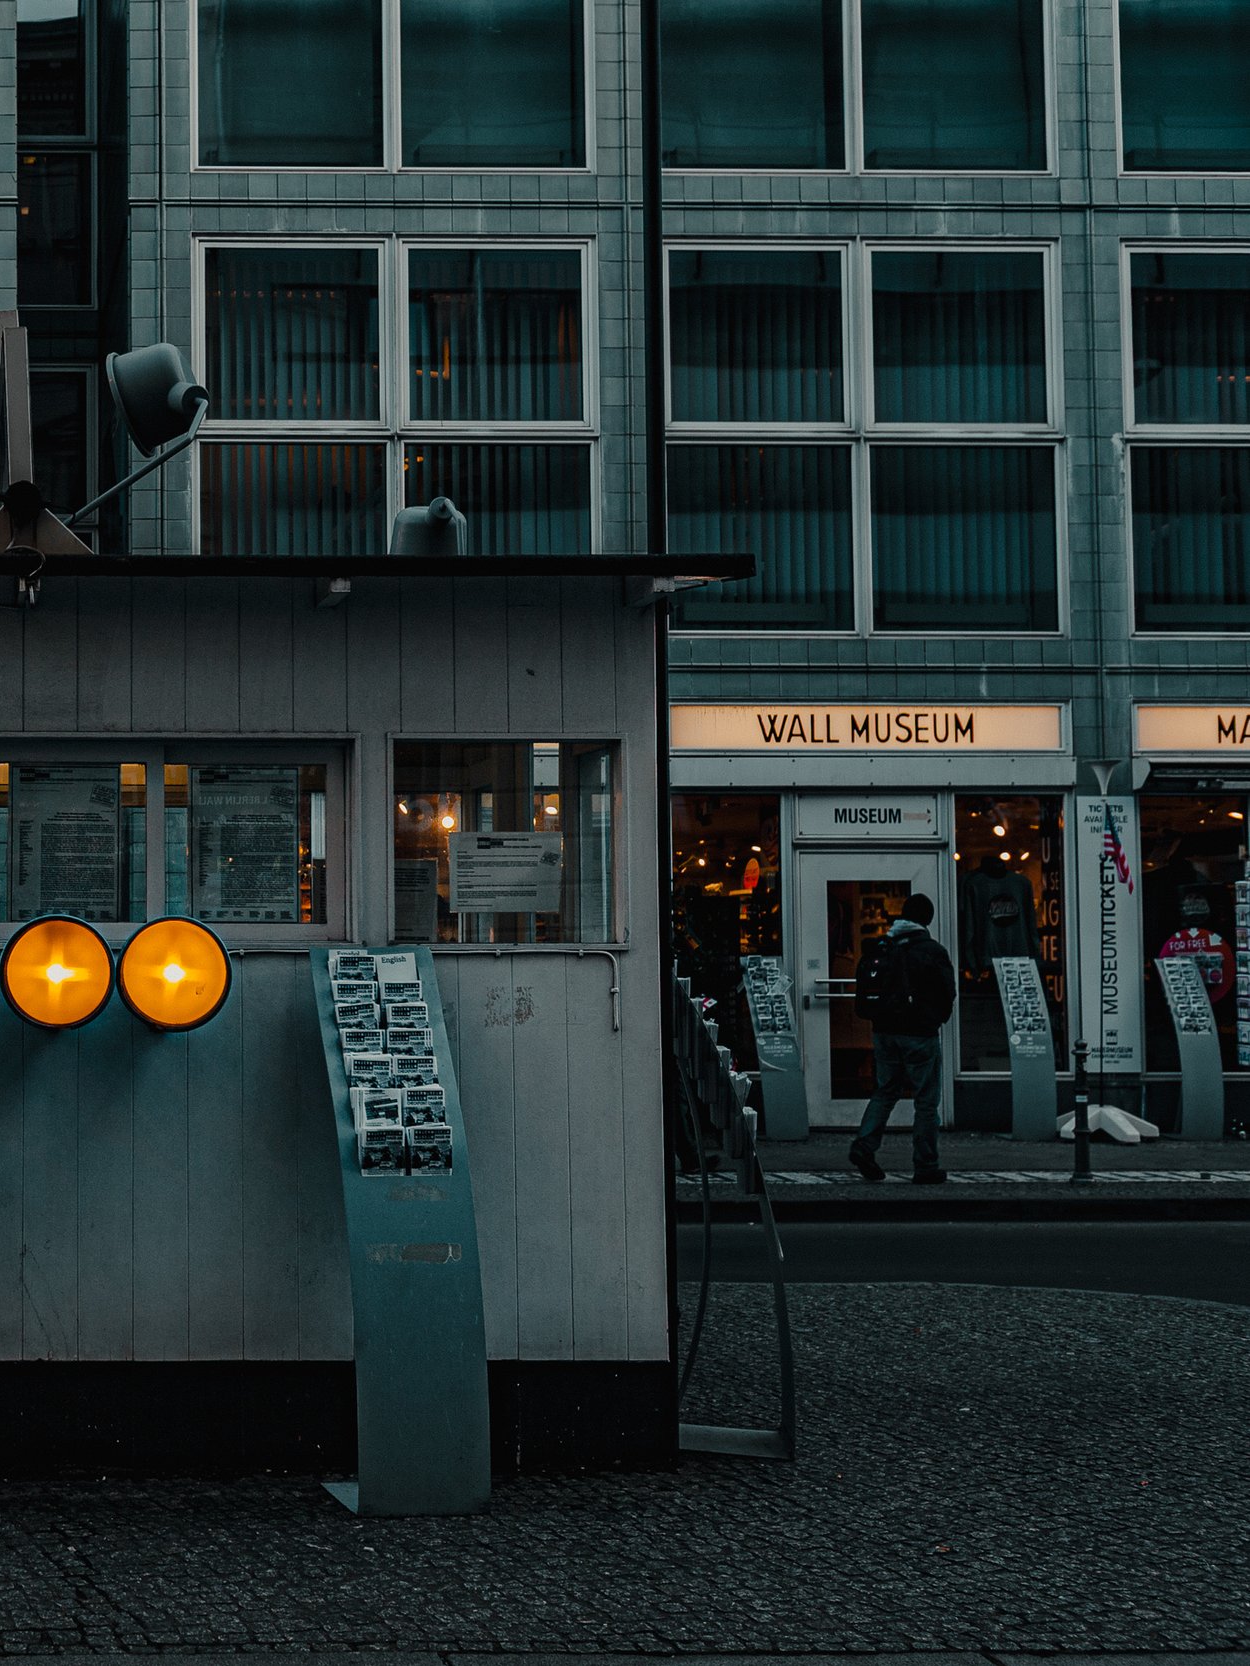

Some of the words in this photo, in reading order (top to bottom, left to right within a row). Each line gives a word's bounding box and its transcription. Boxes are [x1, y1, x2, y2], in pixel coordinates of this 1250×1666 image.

[758, 714, 839, 743] WALL
[851, 713, 975, 743] MUSEUM
[834, 807, 902, 825] MUSEUM
[1169, 941, 1185, 951] FOR
[1187, 938, 1206, 949] FREE
[381, 955, 406, 965] English
